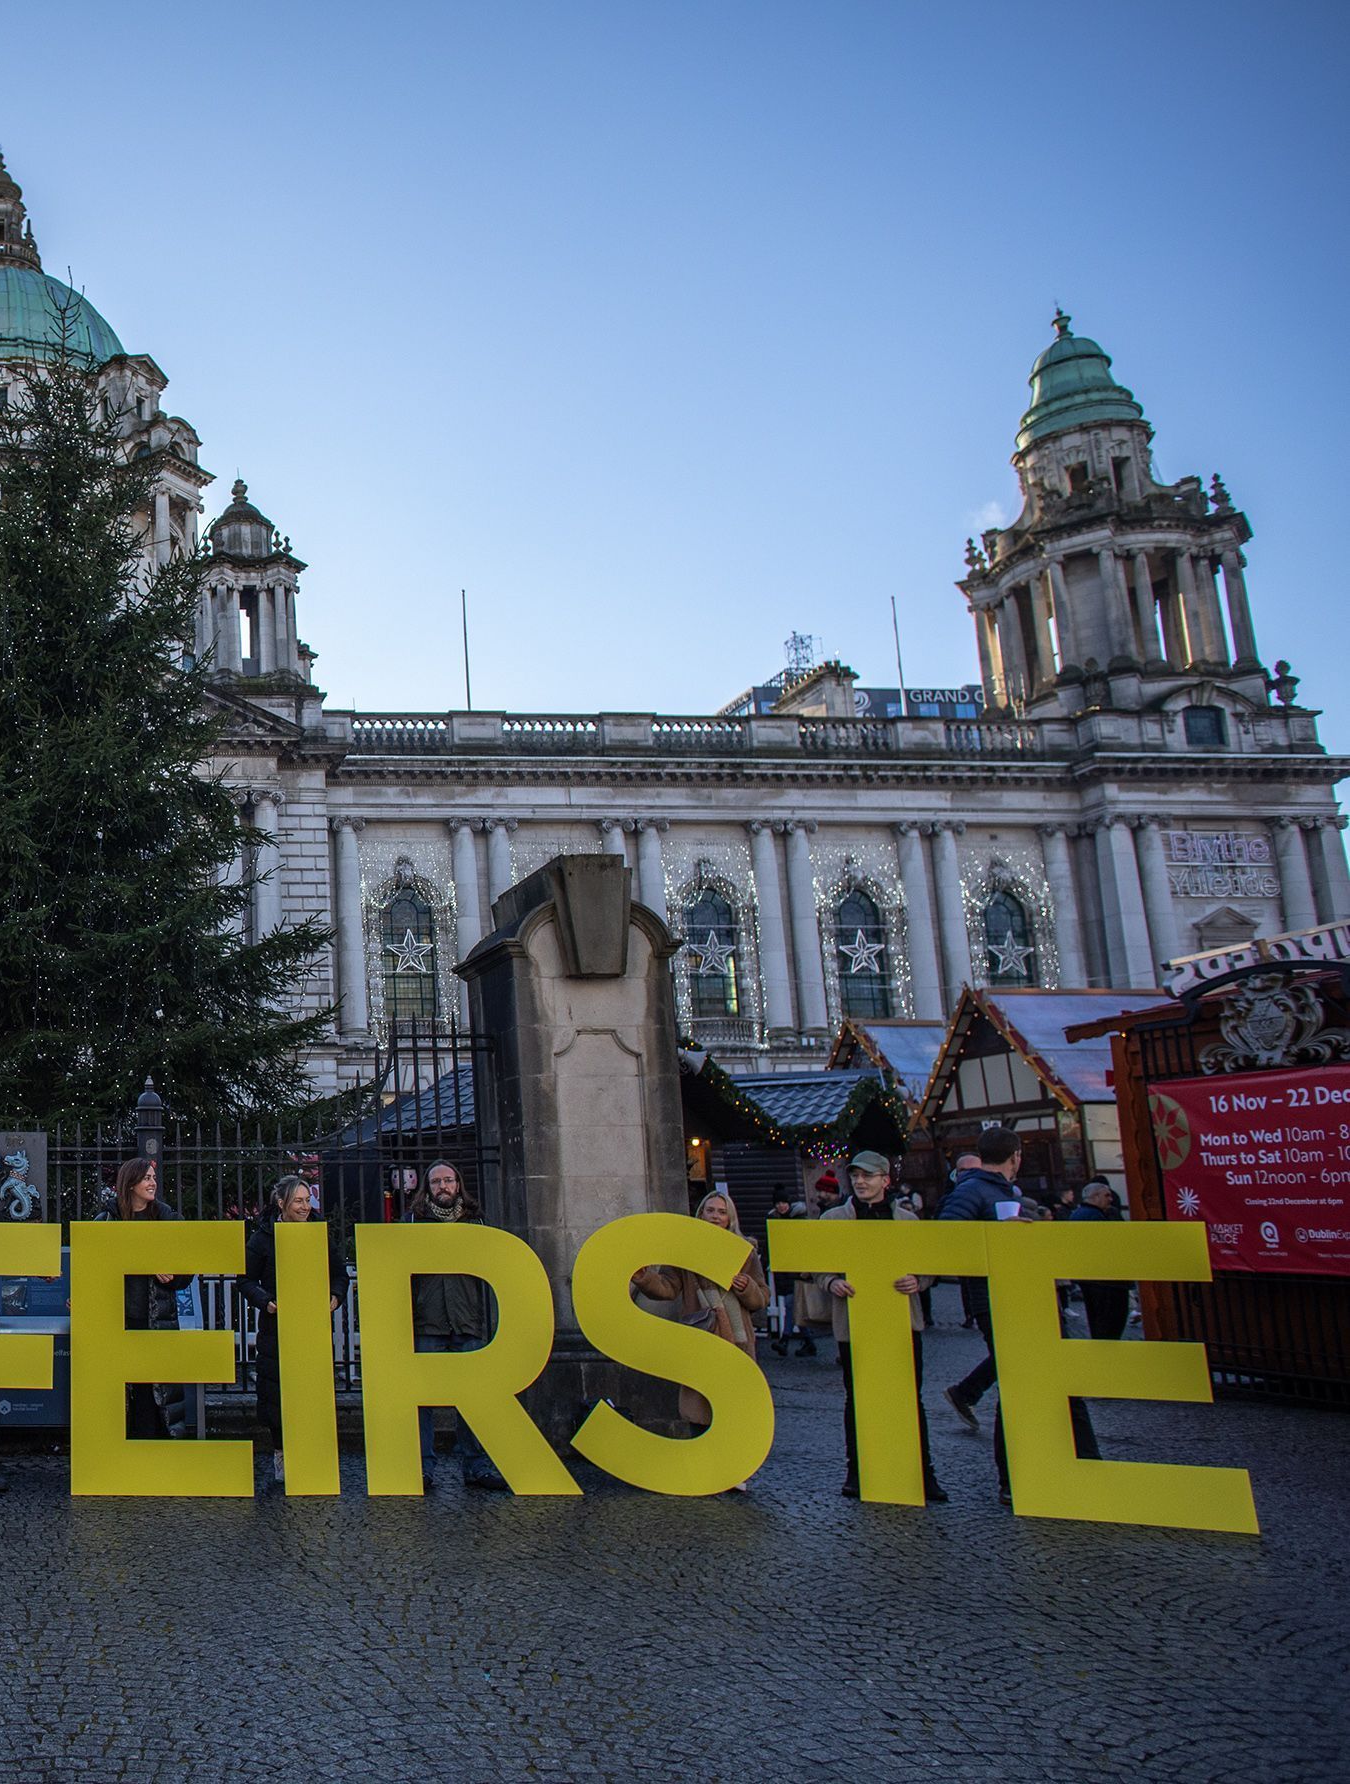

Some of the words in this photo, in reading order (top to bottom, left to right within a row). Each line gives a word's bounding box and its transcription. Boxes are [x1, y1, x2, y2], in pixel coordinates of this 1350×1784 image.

[909, 689, 970, 704] GRAND
[1170, 832, 1270, 869] Blythe
[1168, 868, 1281, 897] Yuletide
[1210, 1095, 1228, 1113] 16
[1232, 1093, 1267, 1112] Nov
[1286, 1088, 1311, 1108] 22
[1314, 1086, 1350, 1106] Dec
[1200, 1133, 1230, 1147] Mon
[1233, 1132, 1248, 1145] to
[1250, 1129, 1283, 1144] Wed
[1285, 1127, 1325, 1142] 10am
[1200, 1151, 1238, 1166] Thurs
[1239, 1151, 1256, 1165] to
[1258, 1149, 1282, 1164] Sat
[1284, 1148, 1324, 1163] 10am
[1225, 1171, 1252, 1185] Sun
[1254, 1169, 1306, 1185] 12noon
[1209, 1223, 1244, 1234] MARKET
